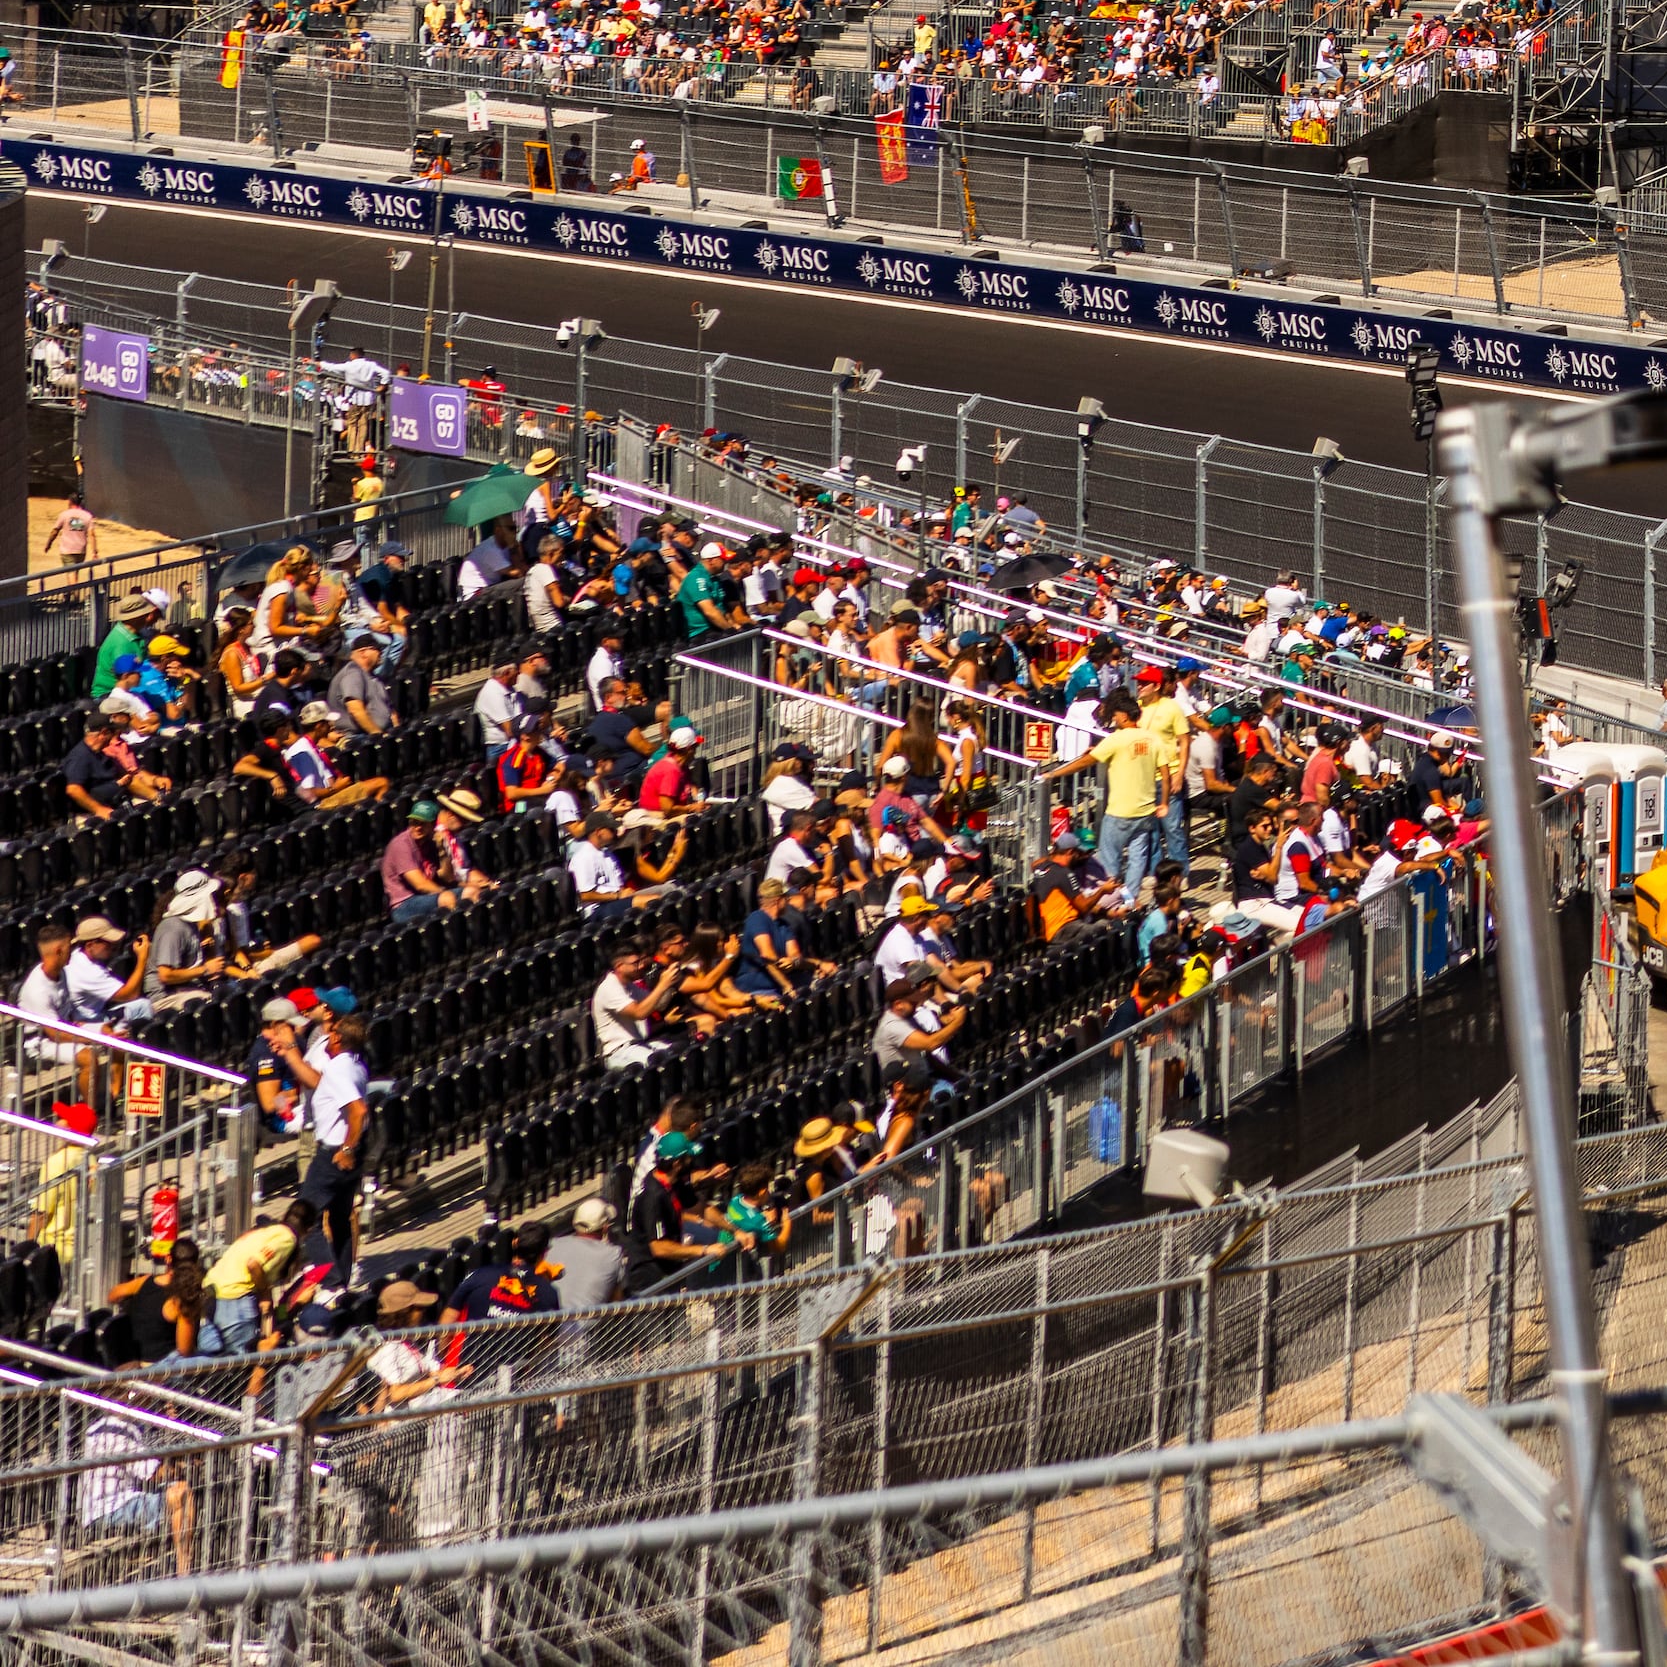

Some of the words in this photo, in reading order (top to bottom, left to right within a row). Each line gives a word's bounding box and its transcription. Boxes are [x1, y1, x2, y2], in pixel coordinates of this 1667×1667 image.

[59, 156, 111, 181] MSC
[62, 180, 112, 192] CRUISES
[163, 168, 214, 193] MSC
[166, 191, 216, 204] CRUISES
[270, 181, 320, 206] MSC
[273, 204, 322, 217] CRUISES
[372, 193, 422, 218] MSC
[375, 217, 424, 230] CRUISES
[476, 207, 526, 232] MSC
[479, 231, 528, 243] CRUISES
[578, 220, 627, 245] MSC
[581, 244, 629, 256] CRUISES
[680, 233, 729, 259] MSC
[684, 258, 731, 270] CRUISES
[780, 246, 829, 271] MSC
[784, 271, 831, 283] CRUISES
[882, 259, 930, 285] MSC
[885, 284, 932, 296] CRUISES
[980, 271, 1028, 297] MSC
[983, 297, 1030, 309] CRUISES
[1081, 285, 1129, 311] MSC
[1084, 310, 1131, 323] CRUISES
[1179, 298, 1227, 325] MSC
[1183, 324, 1229, 337] CRUISES
[1278, 312, 1326, 339] MSC
[1282, 338, 1328, 352] CRUISES
[1374, 324, 1420, 350] MSC
[121, 351, 139, 367] GD
[1378, 352, 1405, 362] CRUI
[1474, 338, 1521, 366] MSC
[1478, 365, 1523, 379] CRUISES
[1569, 351, 1616, 379] MSC
[121, 367, 137, 383] 07
[1574, 379, 1619, 391] CRUISES
[435, 404, 455, 420] GD
[437, 422, 454, 438] 07
[1642, 945, 1664, 967] JCB
